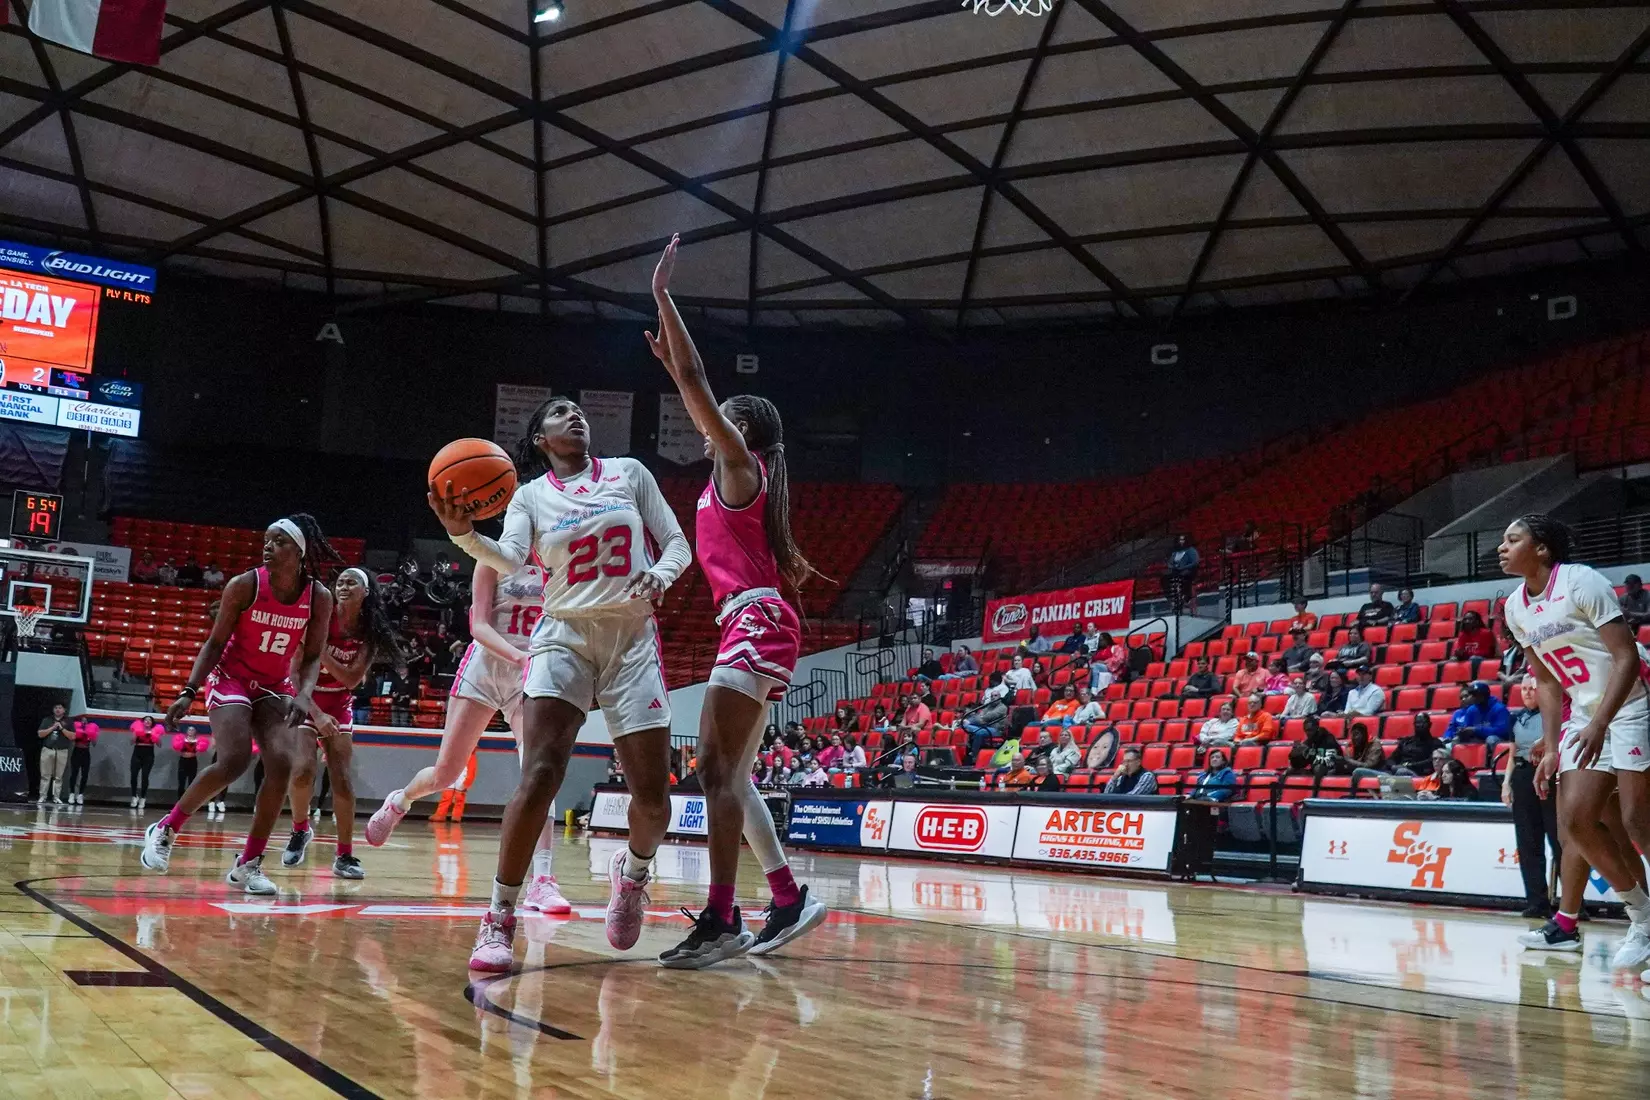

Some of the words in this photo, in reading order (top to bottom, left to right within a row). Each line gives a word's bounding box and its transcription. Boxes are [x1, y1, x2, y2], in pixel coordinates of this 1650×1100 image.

[50, 258, 93, 274] BUD
[92, 266, 150, 284] LIGHT
[106, 288, 121, 299] PLY
[123, 292, 133, 302] FL
[135, 293, 151, 305] PTS
[1547, 295, 1578, 321] D
[316, 323, 345, 344] A
[1151, 344, 1179, 365] C
[736, 354, 760, 374] B
[32, 367, 45, 383] 2
[19, 383, 33, 391] TOL
[104, 387, 134, 396] LIGHT
[2, 394, 33, 404] FIRST
[1, 408, 30, 419] BANK
[74, 402, 125, 418] Charlie's
[67, 412, 98, 424] USED
[101, 417, 132, 429] CARS
[29, 512, 51, 534] 19
[567, 525, 632, 586] 23
[20, 562, 69, 577] PZZAS
[252, 610, 271, 625] SAM
[1031, 602, 1081, 624] CANIAC
[1084, 596, 1125, 617] CREW
[259, 631, 290, 655] 12
[1542, 645, 1590, 689] 15
[685, 801, 704, 814] BUD
[794, 805, 803, 813] The
[803, 805, 821, 814] Official
[679, 814, 705, 828] LIGHT
[792, 816, 811, 825] provider
[831, 817, 854, 826] Athletics
[1045, 809, 1145, 836] ARTECH
[1040, 834, 1067, 844] SIGNS
[1067, 836, 1076, 844] &
[1124, 839, 1144, 848] INC.
[1048, 848, 1130, 863] 936.435.9966
